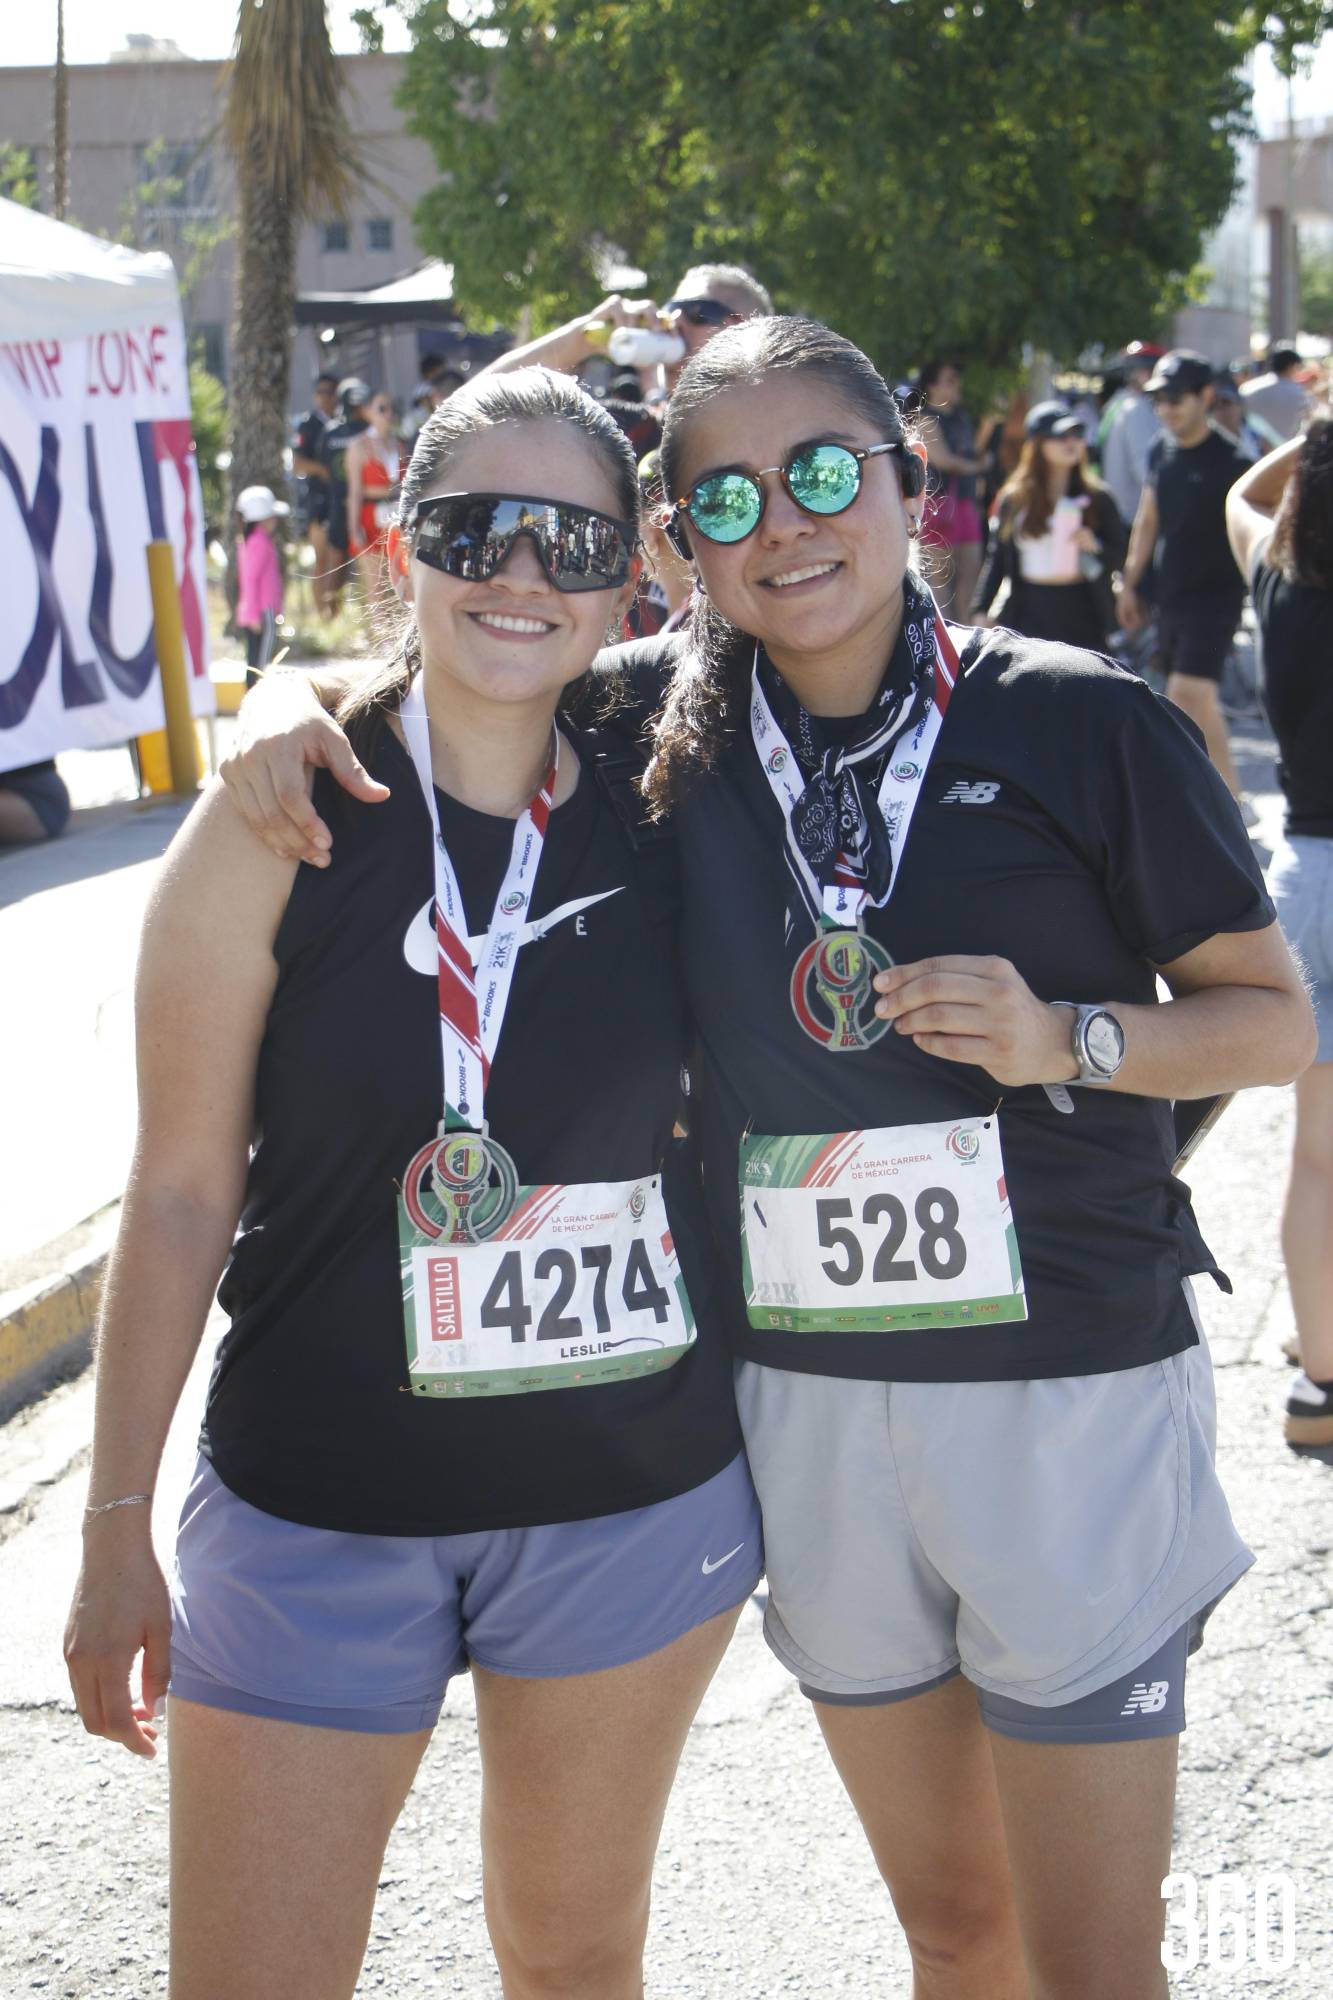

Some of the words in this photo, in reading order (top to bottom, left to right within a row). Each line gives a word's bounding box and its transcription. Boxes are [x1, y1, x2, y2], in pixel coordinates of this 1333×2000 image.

[2, 337, 62, 397] VIP
[493, 946, 507, 968] 21K
[483, 980, 497, 1018] BROOKS
[850, 1162, 862, 1170] LA
[864, 1160, 888, 1169] GRAN
[891, 1153, 933, 1165] CARRERA
[865, 1167, 899, 1178] MÉXICO
[551, 1215, 561, 1223] LA
[563, 1214, 587, 1223] GRAN
[552, 1225, 563, 1233] DE
[815, 1186, 968, 1287] 528
[438, 1261, 456, 1336] SALTILLO
[480, 1238, 671, 1343] 4274
[560, 1340, 612, 1359] LESLIE
